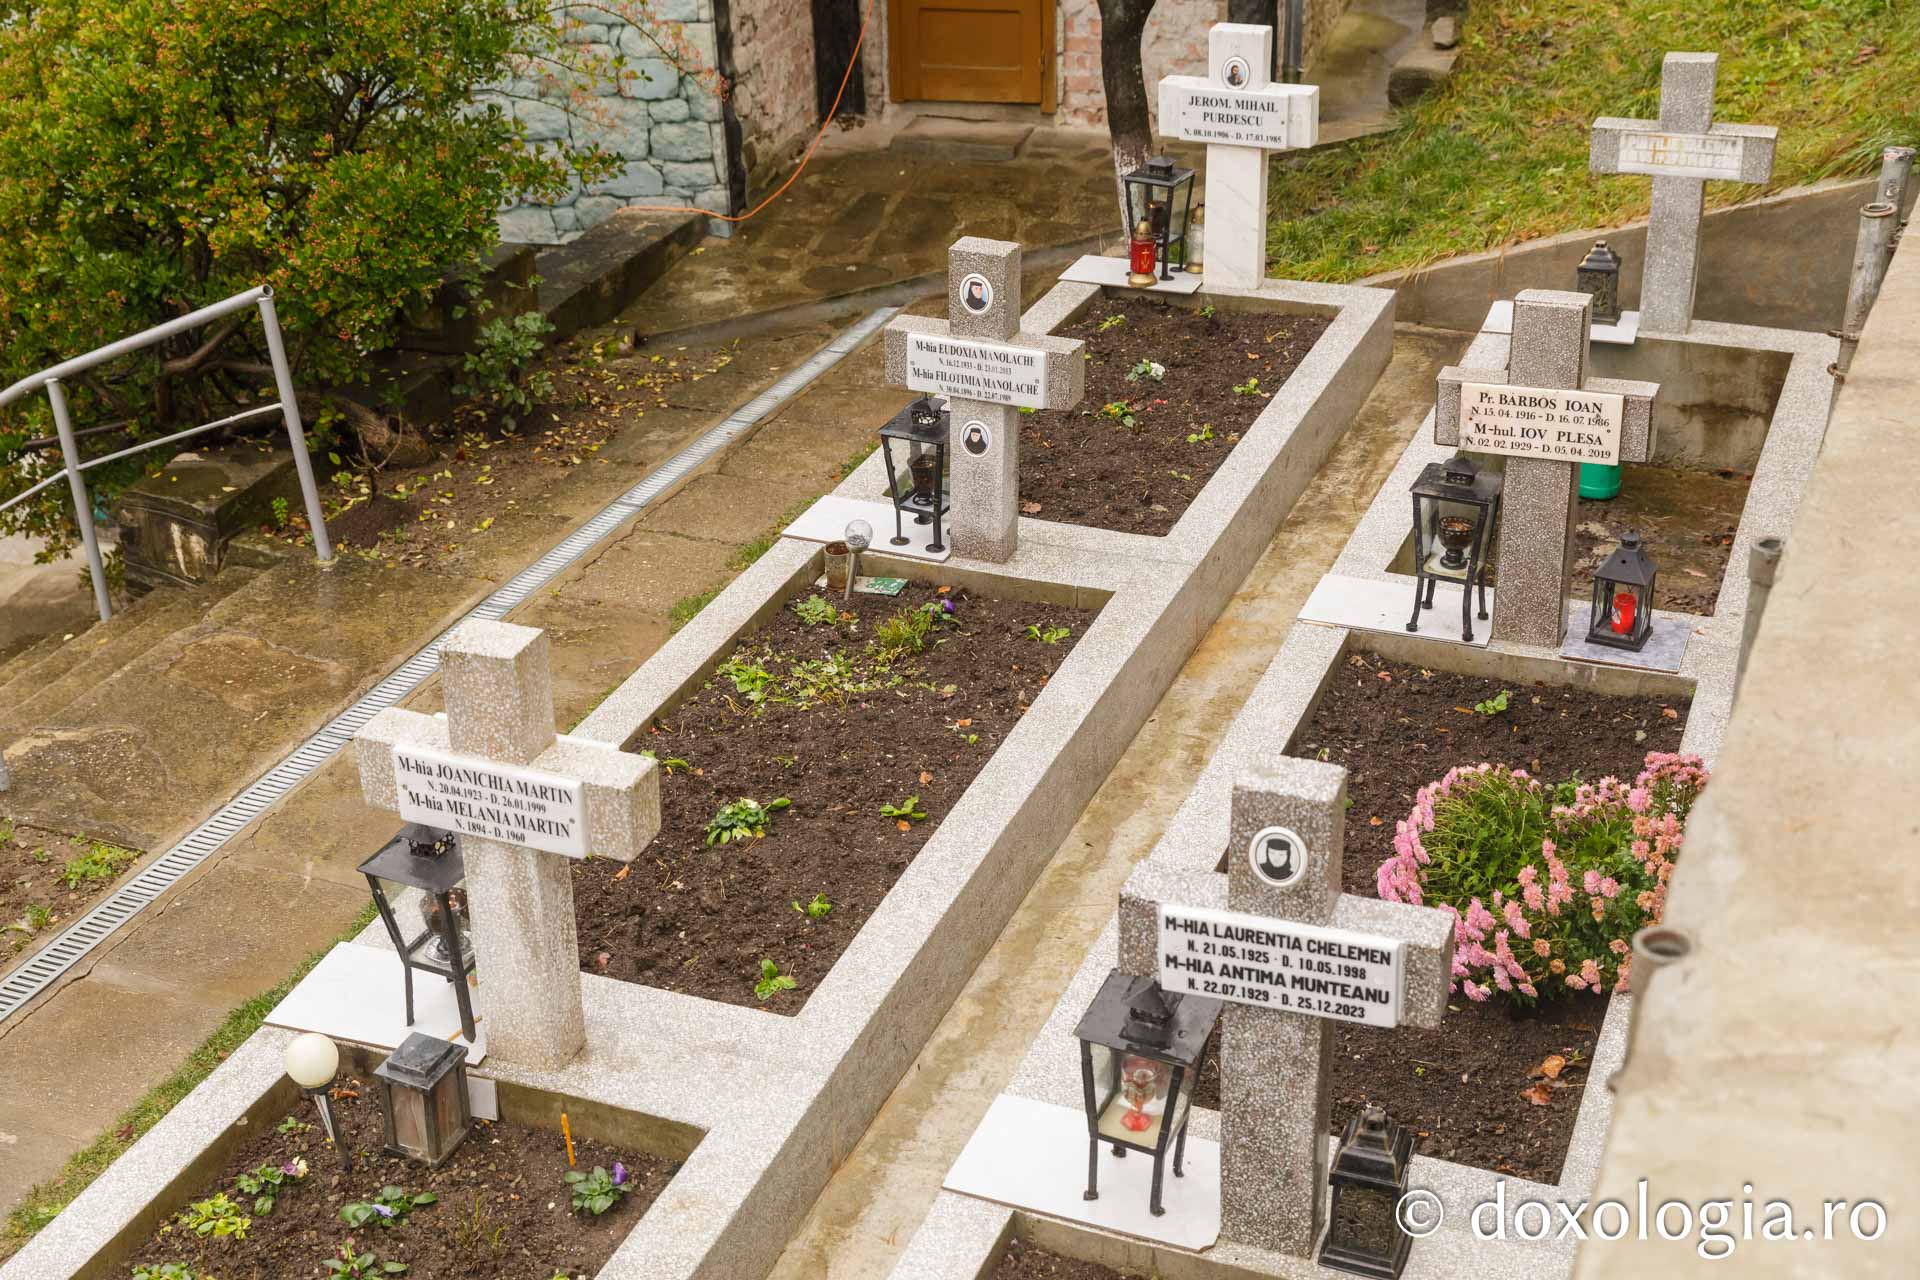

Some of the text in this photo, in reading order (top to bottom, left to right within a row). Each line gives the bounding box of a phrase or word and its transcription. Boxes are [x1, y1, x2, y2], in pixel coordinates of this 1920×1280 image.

[1203, 111, 1263, 126] PURDESCU
[1234, 99, 1278, 113] MIHAIL
[915, 340, 1036, 367] M-hia EUDOXIA MANOLACHE
[912, 367, 1039, 395] M-hia FILOTIMIA MANOLACHE
[1471, 406, 1481, 415] N.
[1516, 410, 1536, 420] 1916
[1546, 413, 1556, 423] D.
[1480, 392, 1495, 404] Pr.
[1565, 400, 1603, 414] IOAN
[1474, 423, 1516, 438] M-hul.
[1519, 427, 1548, 440] IOV
[1465, 437, 1476, 446] N.
[1510, 441, 1532, 451] 1929
[1542, 444, 1552, 453] D.
[1588, 448, 1611, 459] 2019
[398, 755, 573, 804] M-hia JOANICHIA MARTIN
[427, 780, 437, 792] N.
[440, 781, 483, 800] 20.04.1923
[490, 793, 500, 805] D.
[503, 796, 546, 813] 26.01.1999
[408, 791, 570, 838] M-hia MELANIA MARTIN
[455, 818, 465, 830] N.
[467, 821, 486, 835] 1894
[494, 828, 504, 839] D.
[506, 830, 526, 843] 1960
[1165, 916, 1391, 966] M-HIA LAURENTIA CHELEMEN
[1187, 940, 1198, 952] N.
[1203, 942, 1270, 963] 21.05.1925
[1282, 955, 1293, 968] D.
[1299, 957, 1366, 980] 10.05.1998
[1165, 954, 1390, 1005] M-HIA ANTIMA MUNTEANU
[1188, 978, 1199, 991] N.
[1203, 980, 1269, 1002] 22.07.1929
[1282, 993, 1293, 1007] D.
[1297, 996, 1365, 1018] 25.12.2023
